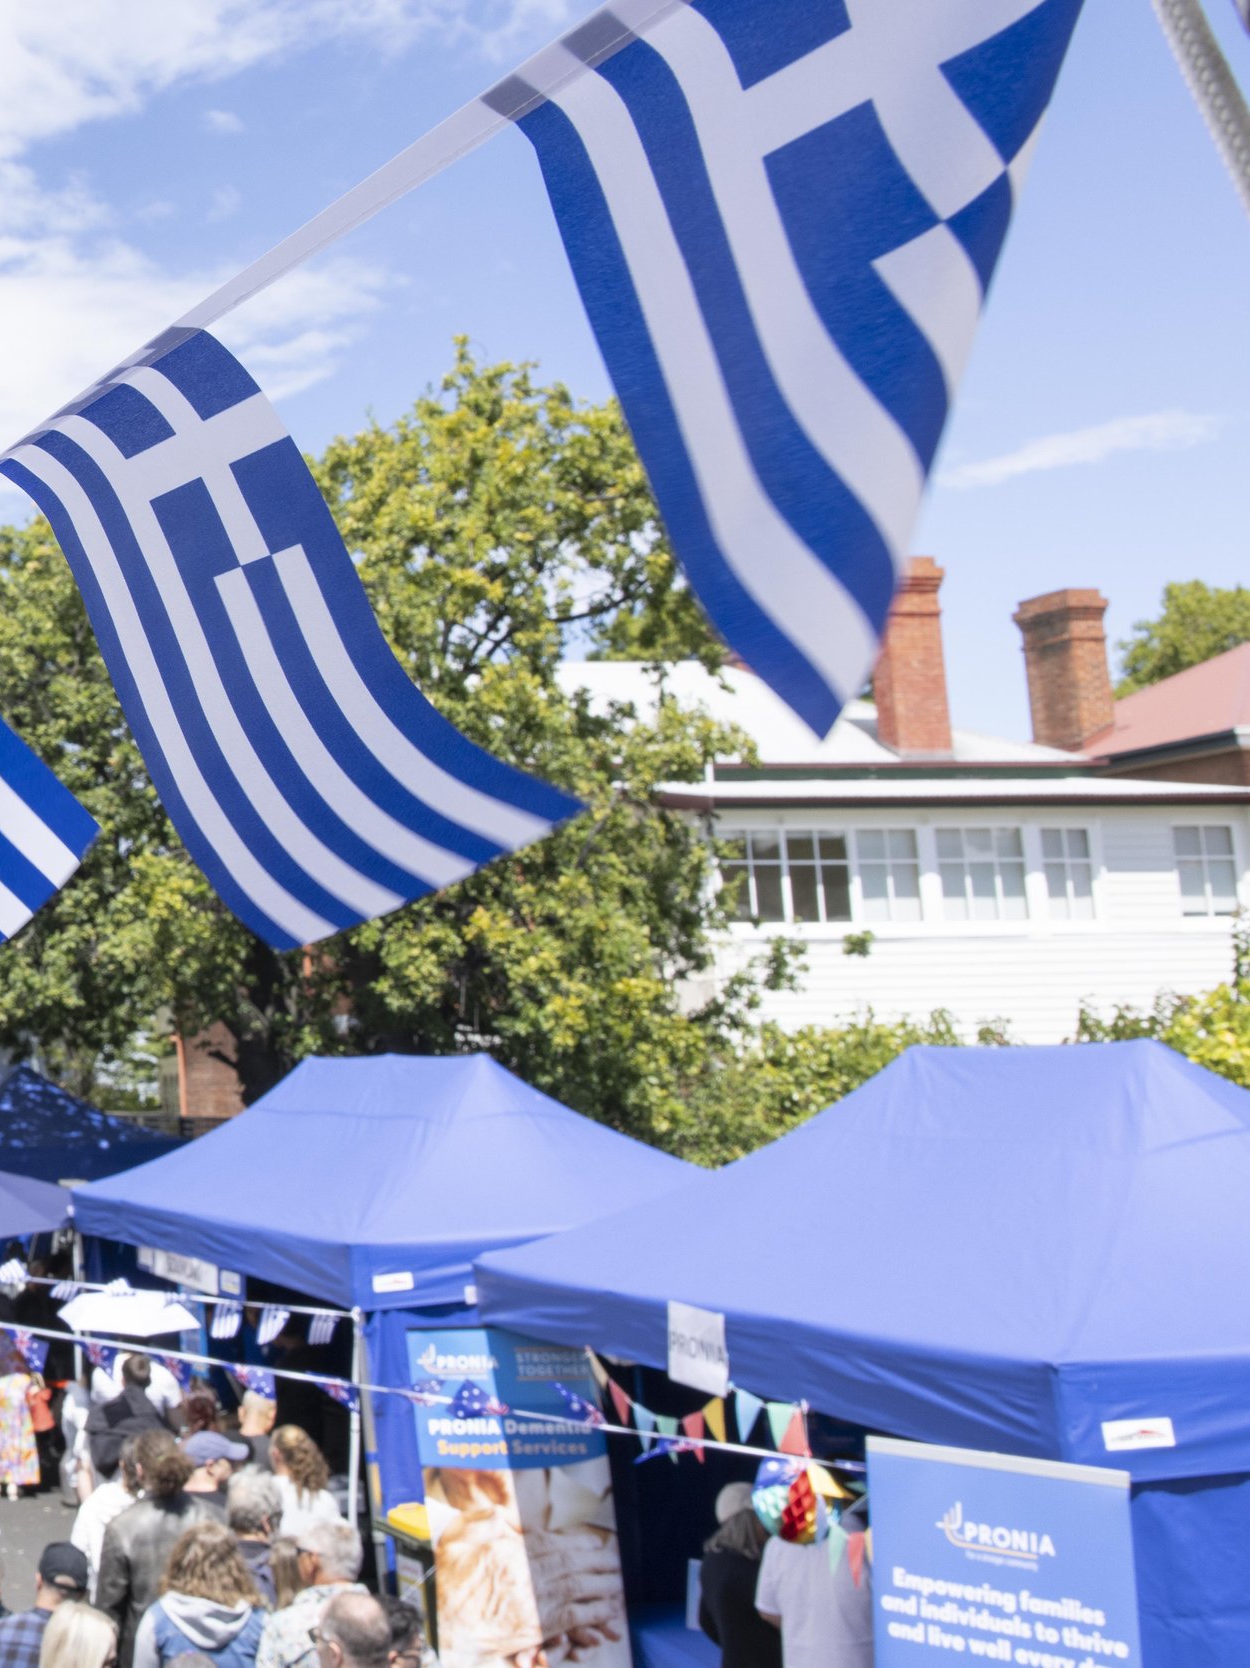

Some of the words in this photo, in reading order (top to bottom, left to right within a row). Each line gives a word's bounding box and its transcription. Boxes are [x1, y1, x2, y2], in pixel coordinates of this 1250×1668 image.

[436, 1354, 499, 1370] PRONIA
[669, 1331, 726, 1364] PRONIA
[427, 1418, 501, 1436] PRONIA
[504, 1418, 592, 1435] Dementia
[437, 1439, 508, 1458] Support
[511, 1440, 588, 1455] Services
[964, 1521, 1057, 1557] PRONIA
[892, 1566, 1017, 1613] Empowering
[1019, 1590, 1106, 1626] families
[880, 1594, 917, 1616] and
[919, 1597, 1032, 1639] individuals
[1034, 1621, 1060, 1644] to
[1061, 1626, 1129, 1659] thrive
[887, 1621, 925, 1643] and
[927, 1625, 966, 1652] live
[968, 1638, 1012, 1662] well
